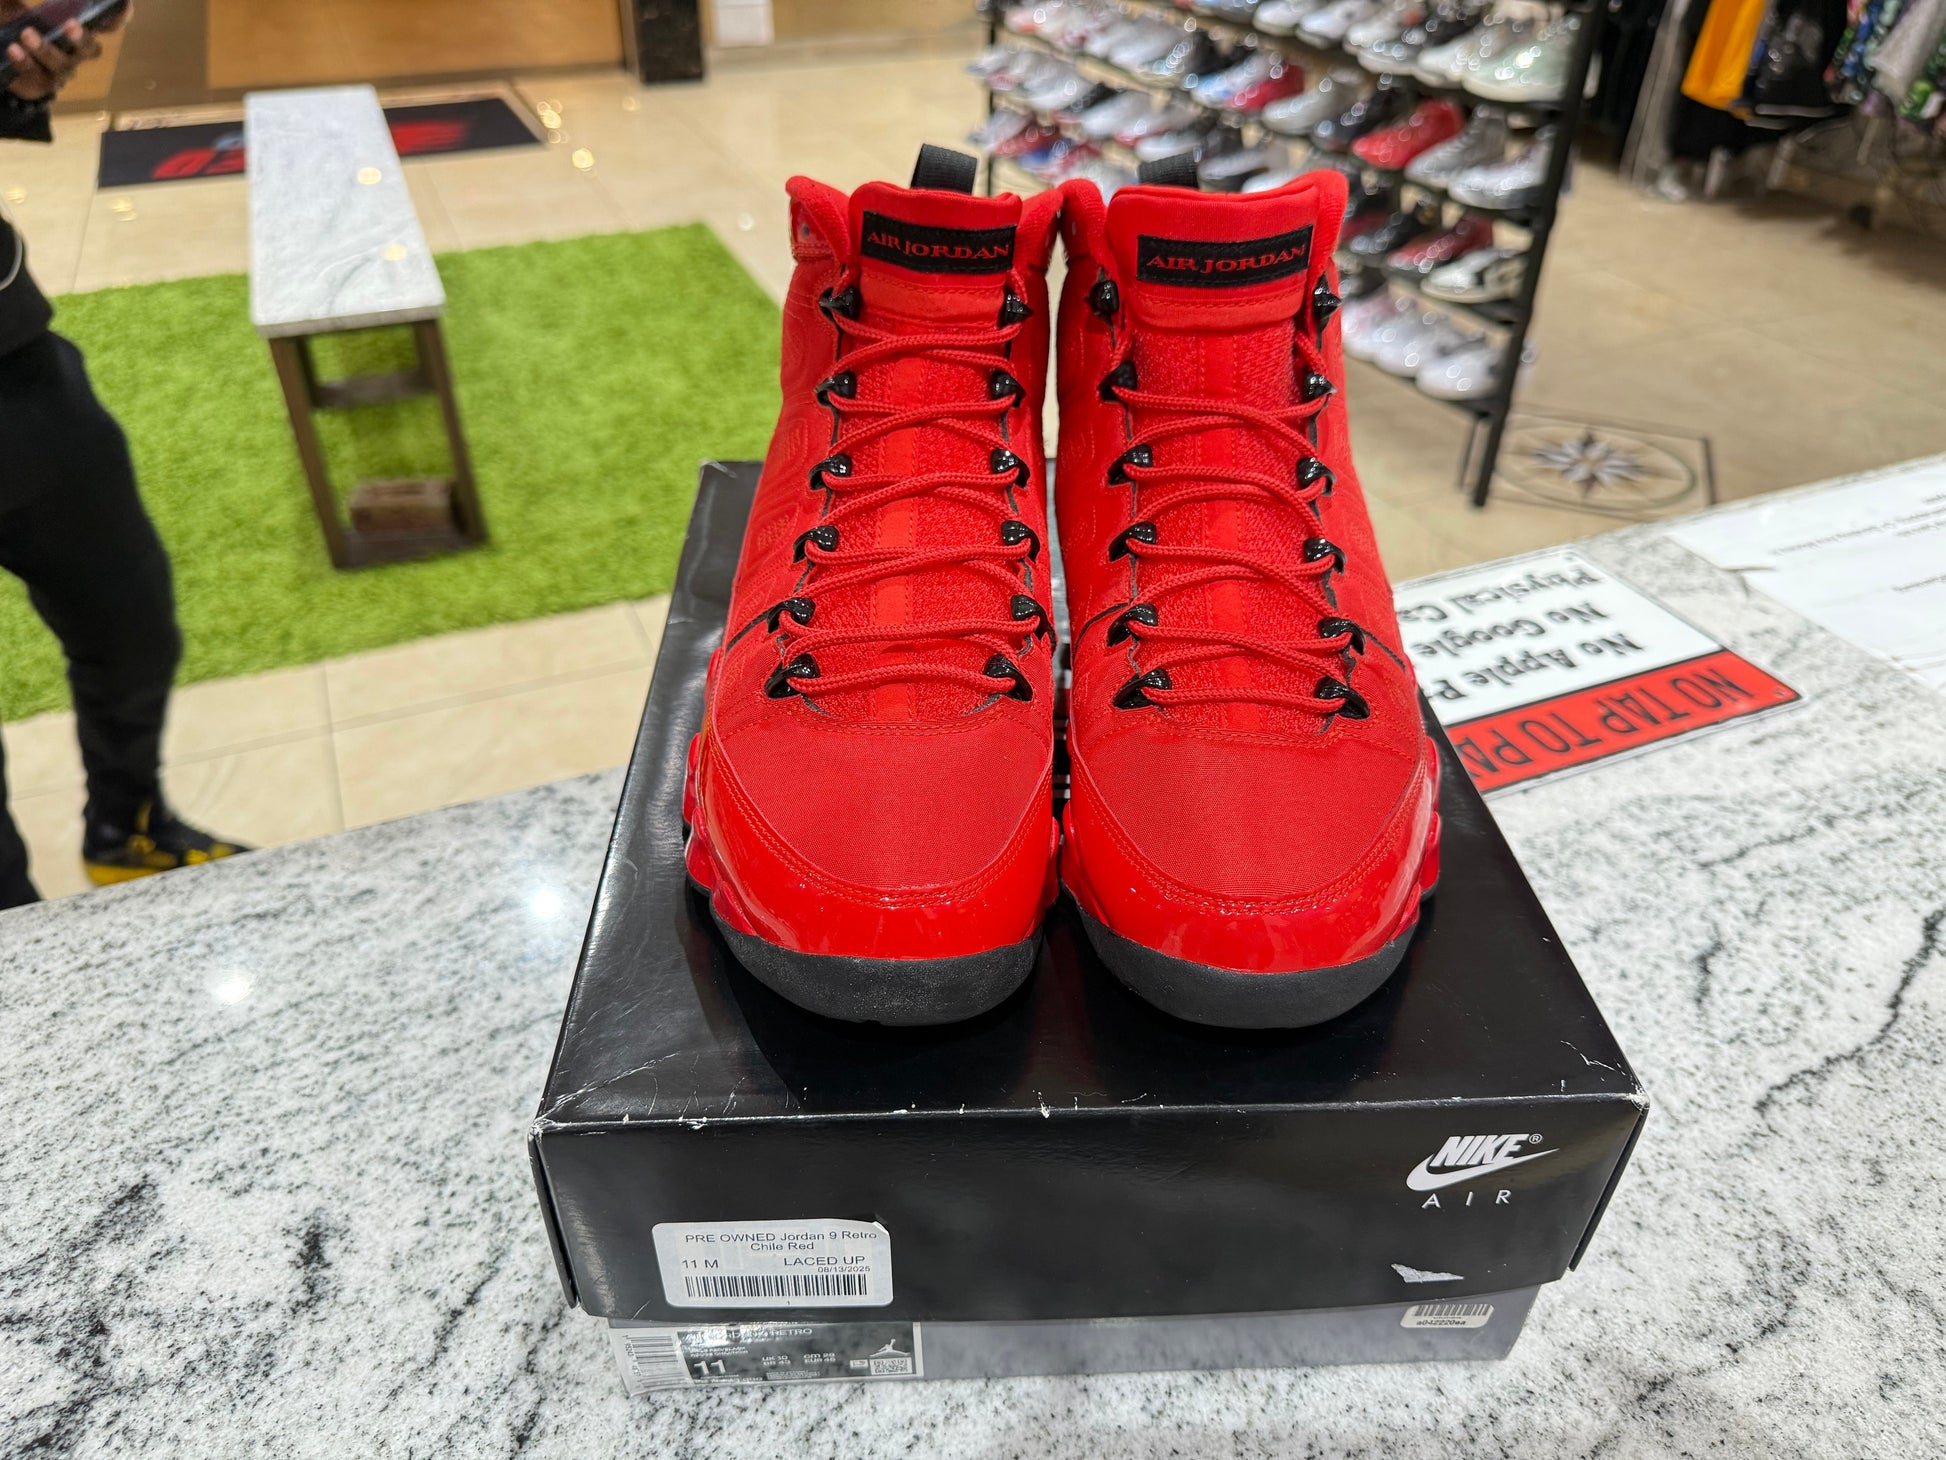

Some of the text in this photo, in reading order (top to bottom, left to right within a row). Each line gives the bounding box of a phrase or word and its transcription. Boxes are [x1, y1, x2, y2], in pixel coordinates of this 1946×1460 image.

[867, 231, 1010, 260] AIR JORDAN
[1147, 244, 1307, 274] AIR JORDAN
[1446, 568, 1601, 615] Physical
[1409, 602, 1610, 657] No Google
[1428, 633, 1644, 701] No Apple P
[1453, 668, 1755, 778] NO TAP TO PA
[1428, 1133, 1531, 1167] NIKE
[1421, 1189, 1512, 1209] AIR
[685, 1230, 877, 1243] PRE OWNED Jordan 9 Retro
[750, 1241, 815, 1251] Chile Red
[682, 1259, 719, 1269] 11 M
[784, 1255, 865, 1266] LACED UP
[817, 1265, 871, 1273] 08/13/2025
[771, 1327, 813, 1337] RETRO
[693, 1359, 726, 1376] 11
